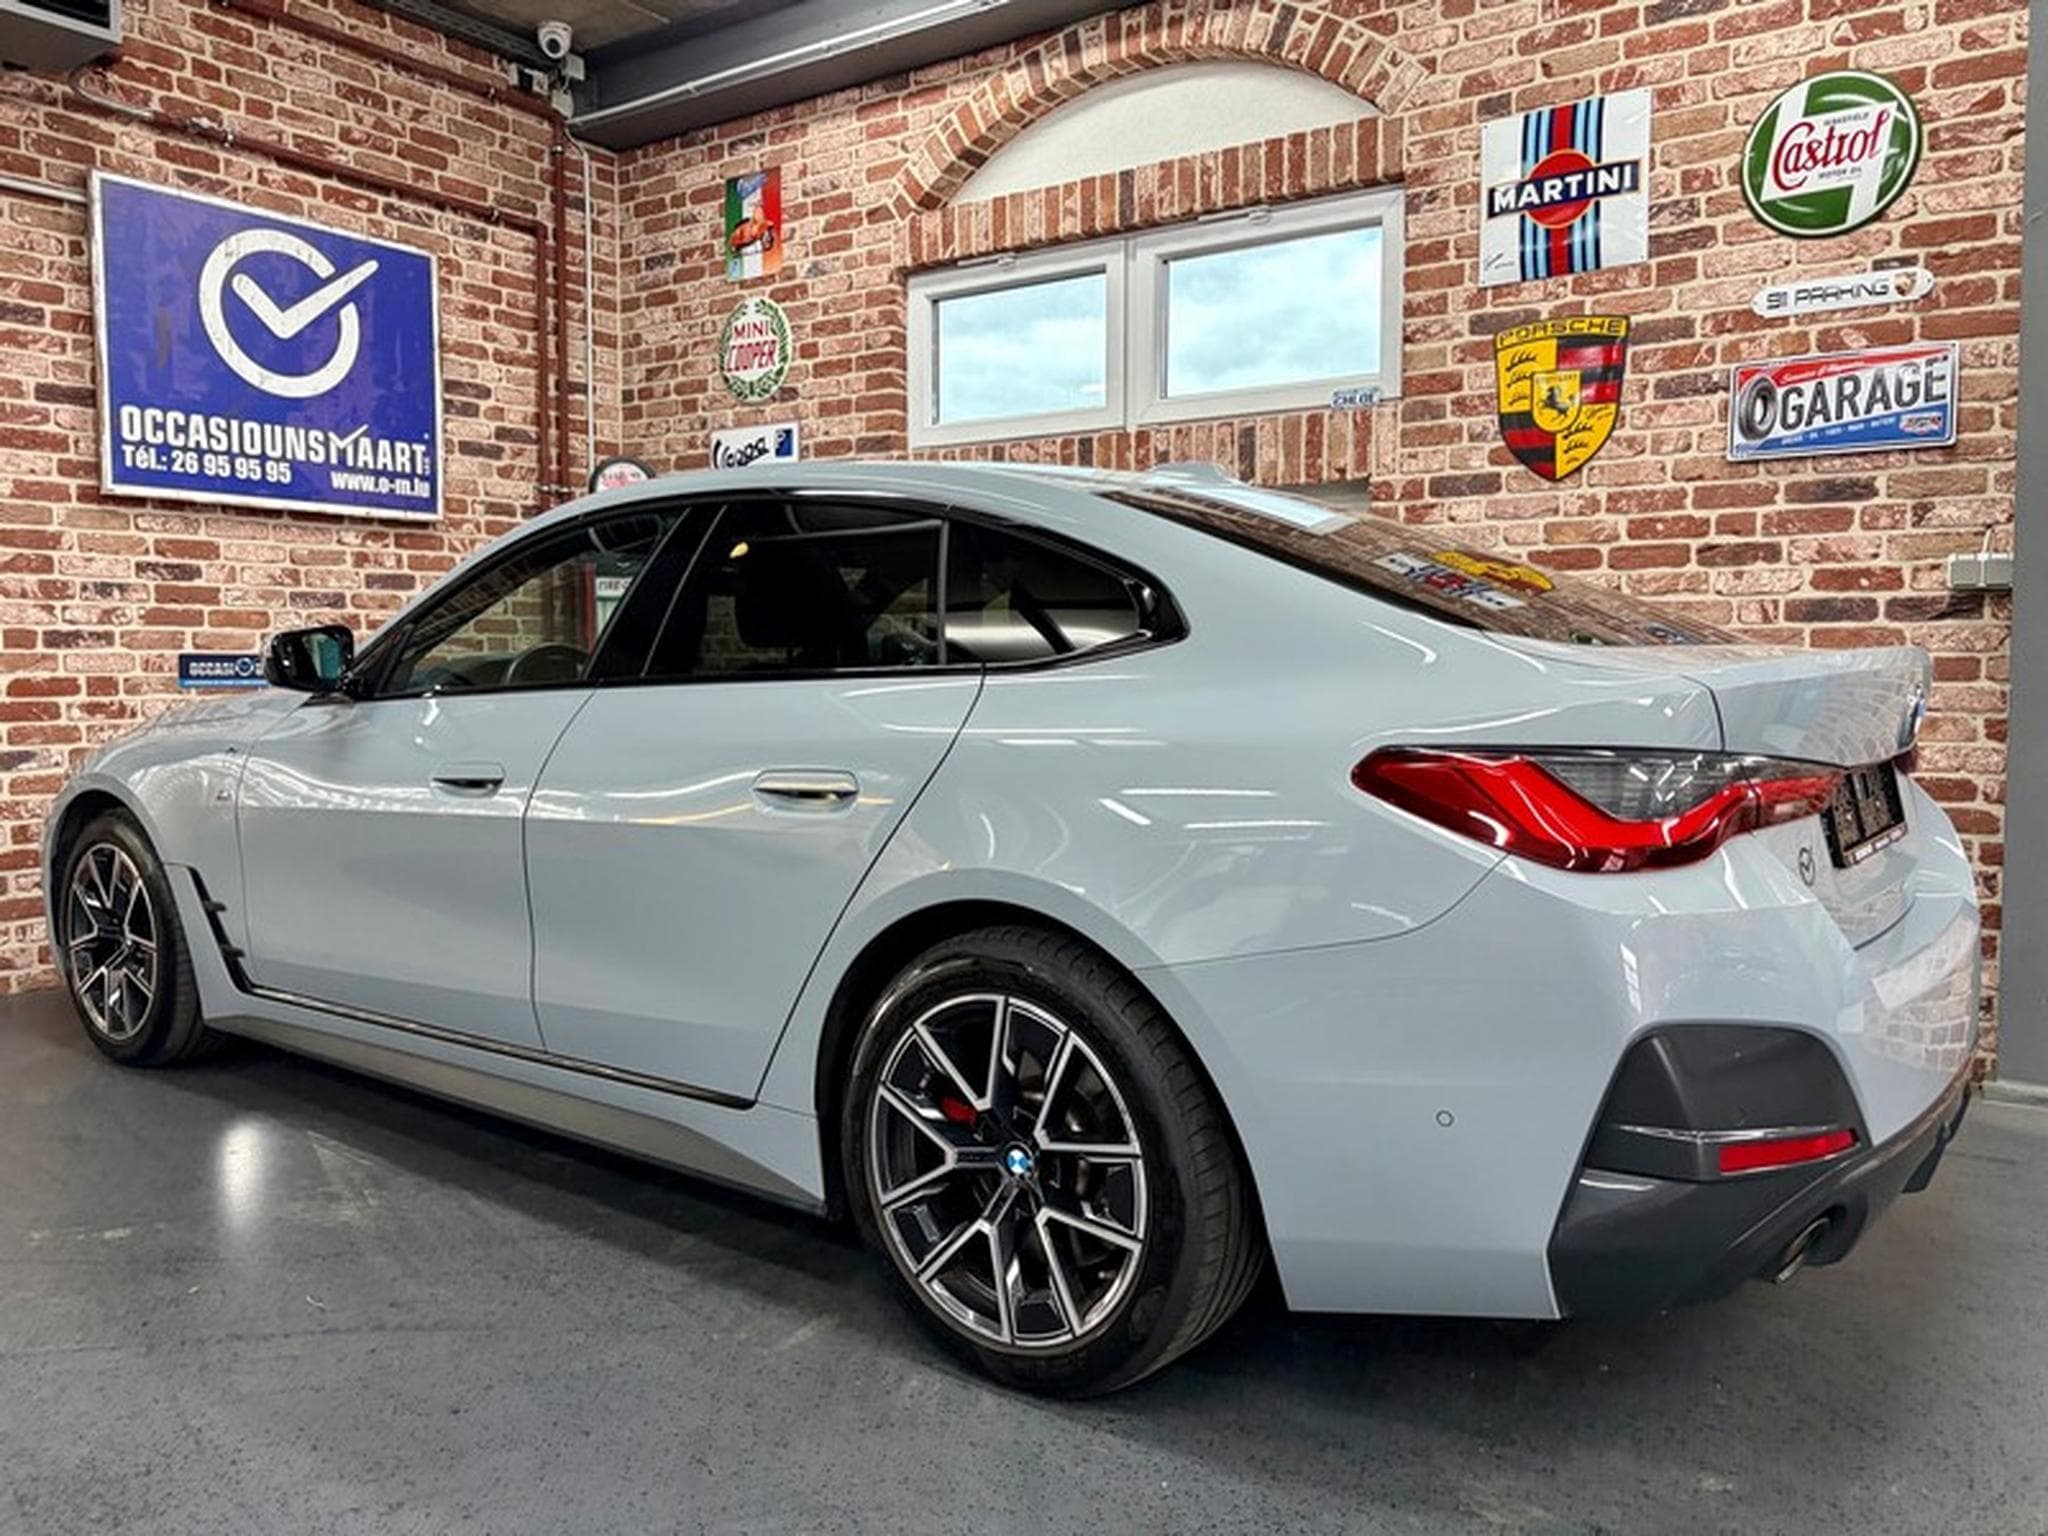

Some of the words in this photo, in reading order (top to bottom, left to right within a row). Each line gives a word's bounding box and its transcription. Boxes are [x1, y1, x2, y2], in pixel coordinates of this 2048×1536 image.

[1772, 107, 1890, 193] Castrol
[1493, 164, 1632, 214] MARTINI
[1794, 278, 1890, 306] PARKING
[733, 319, 769, 340] MINI
[1499, 318, 1624, 347] PORSCHE
[726, 338, 778, 372] COOPER
[1780, 355, 1949, 432] GARAGE
[171, 449, 199, 475] 26
[203, 455, 229, 478] 95
[235, 459, 262, 482] 95
[265, 462, 292, 484] 95
